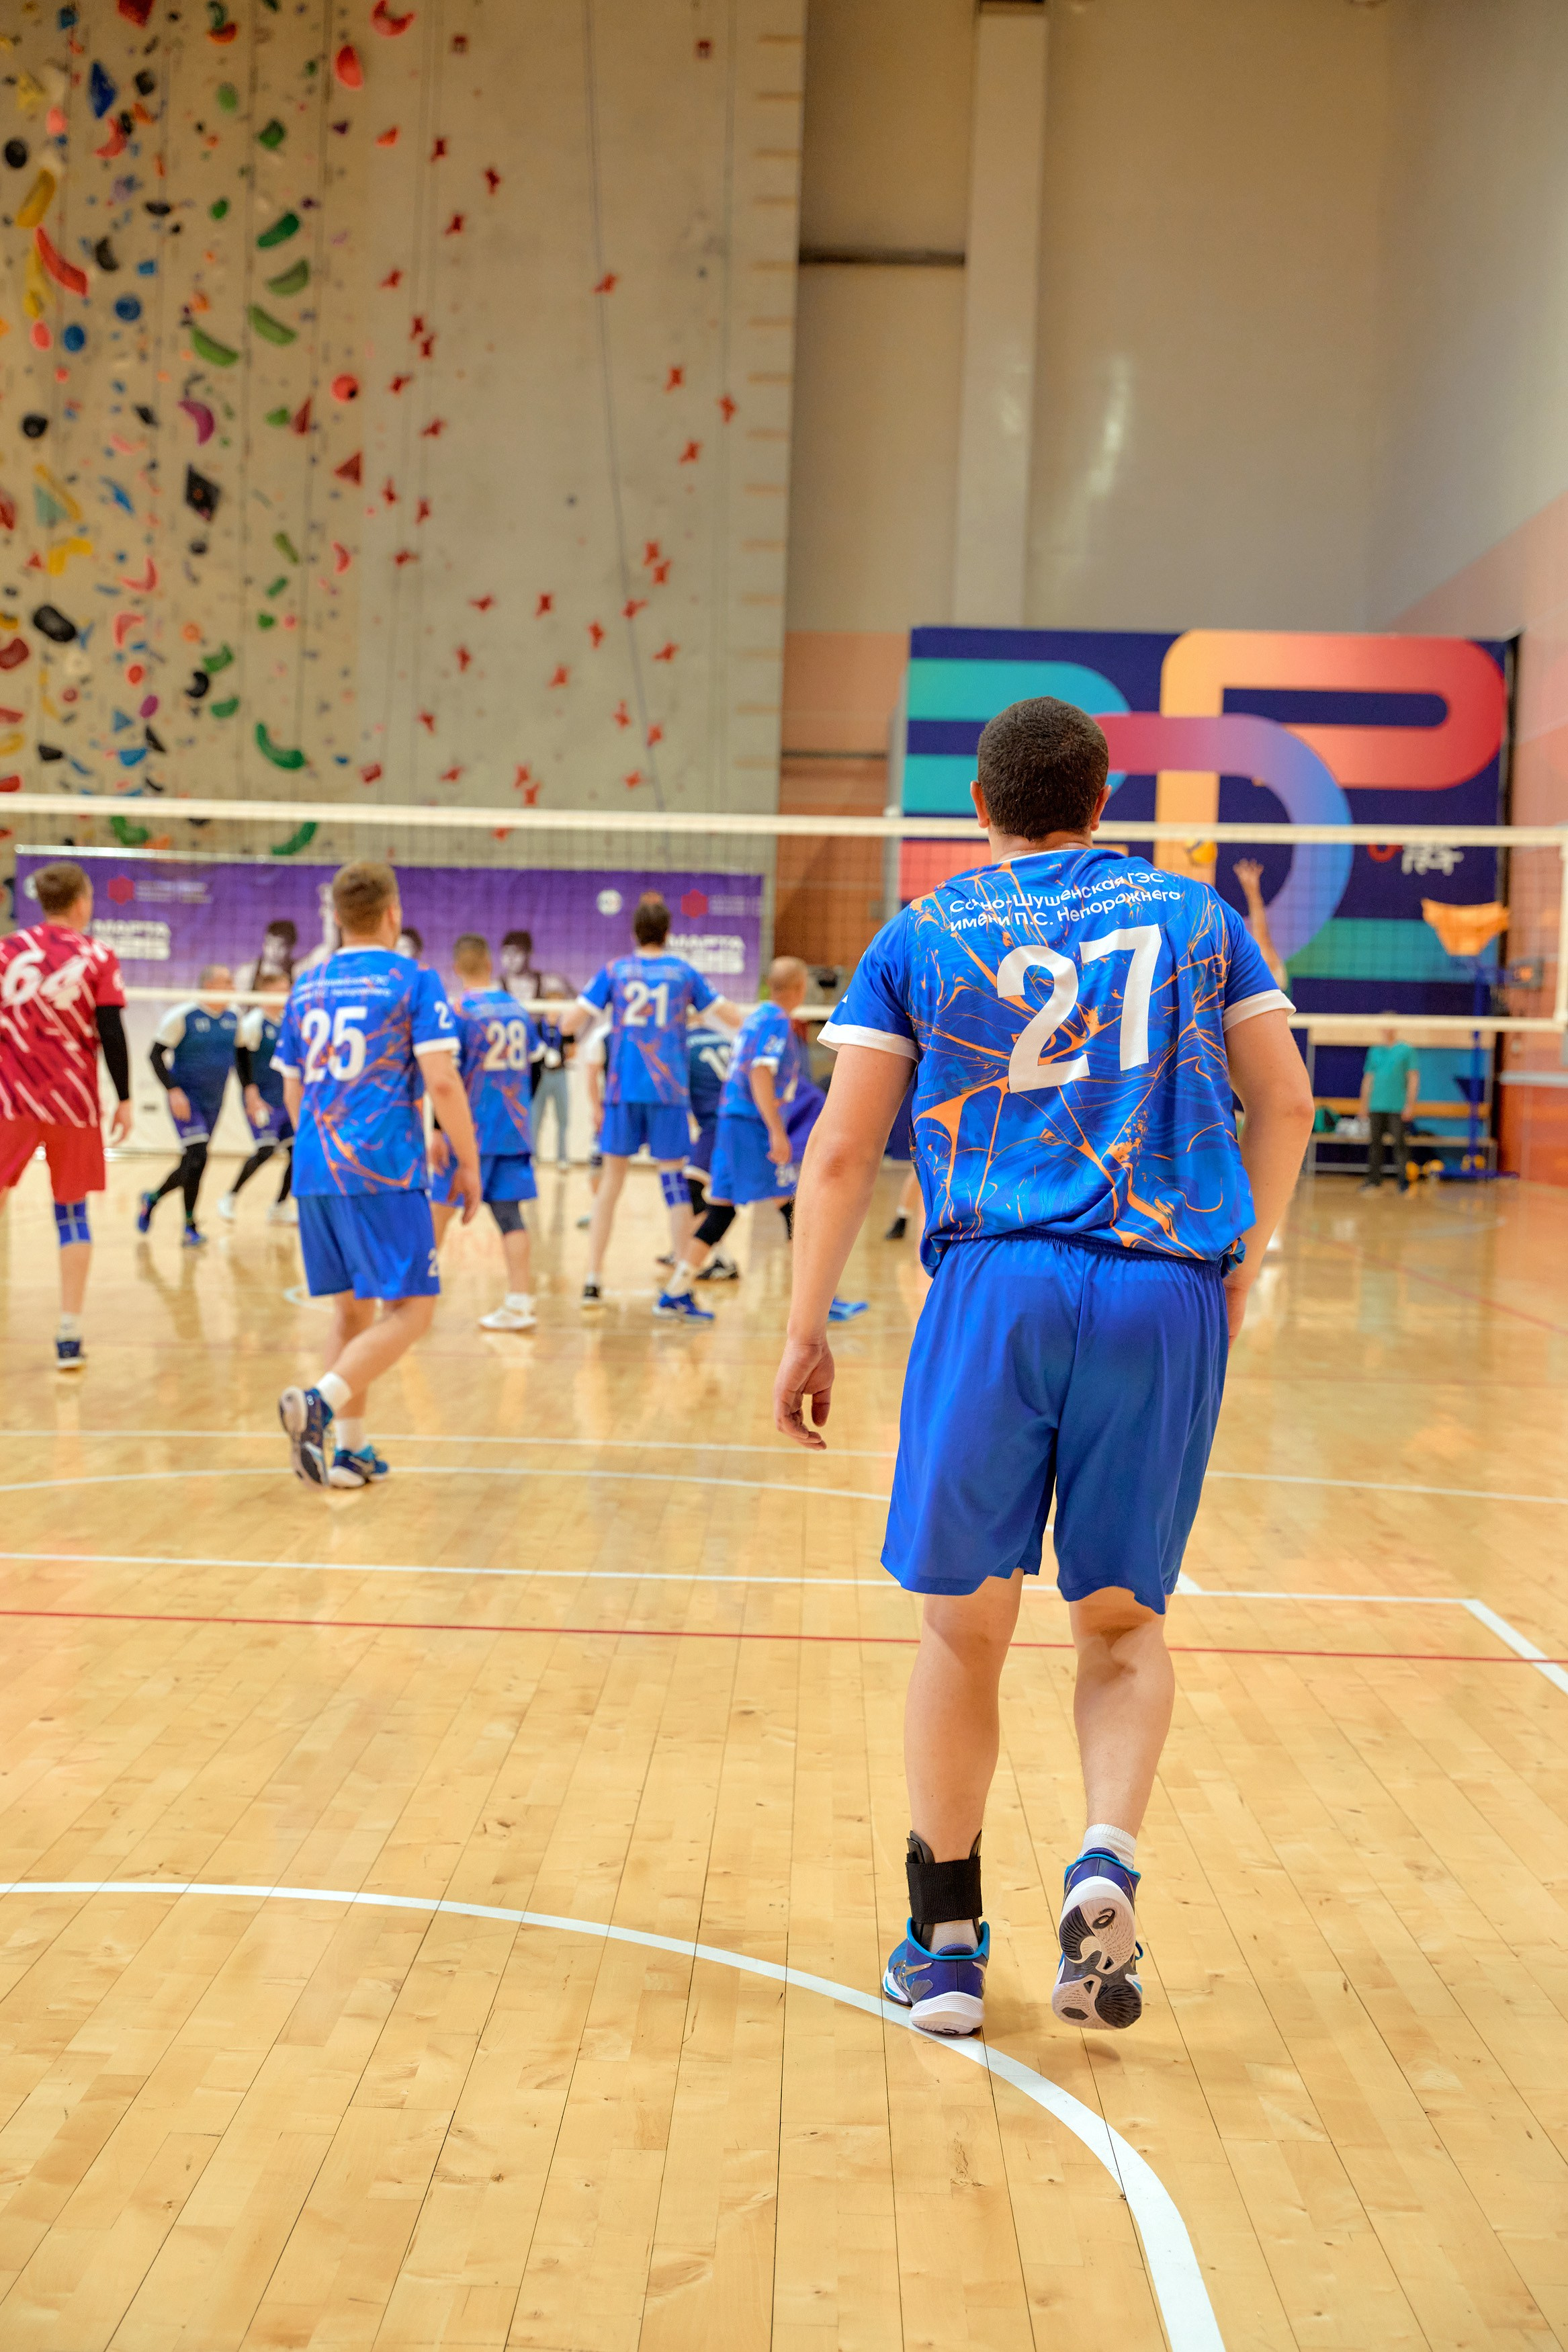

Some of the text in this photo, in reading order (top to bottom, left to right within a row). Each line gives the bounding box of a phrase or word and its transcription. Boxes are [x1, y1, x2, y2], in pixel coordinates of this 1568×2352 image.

[1127, 872, 1164, 884] ГЭС
[951, 889, 1181, 932] имени П.С. Непорожнего
[2, 950, 88, 1011] 64
[623, 980, 669, 1028] 21
[997, 923, 1162, 1093] 27
[301, 1005, 368, 1084] 25
[482, 1019, 527, 1071] 28
